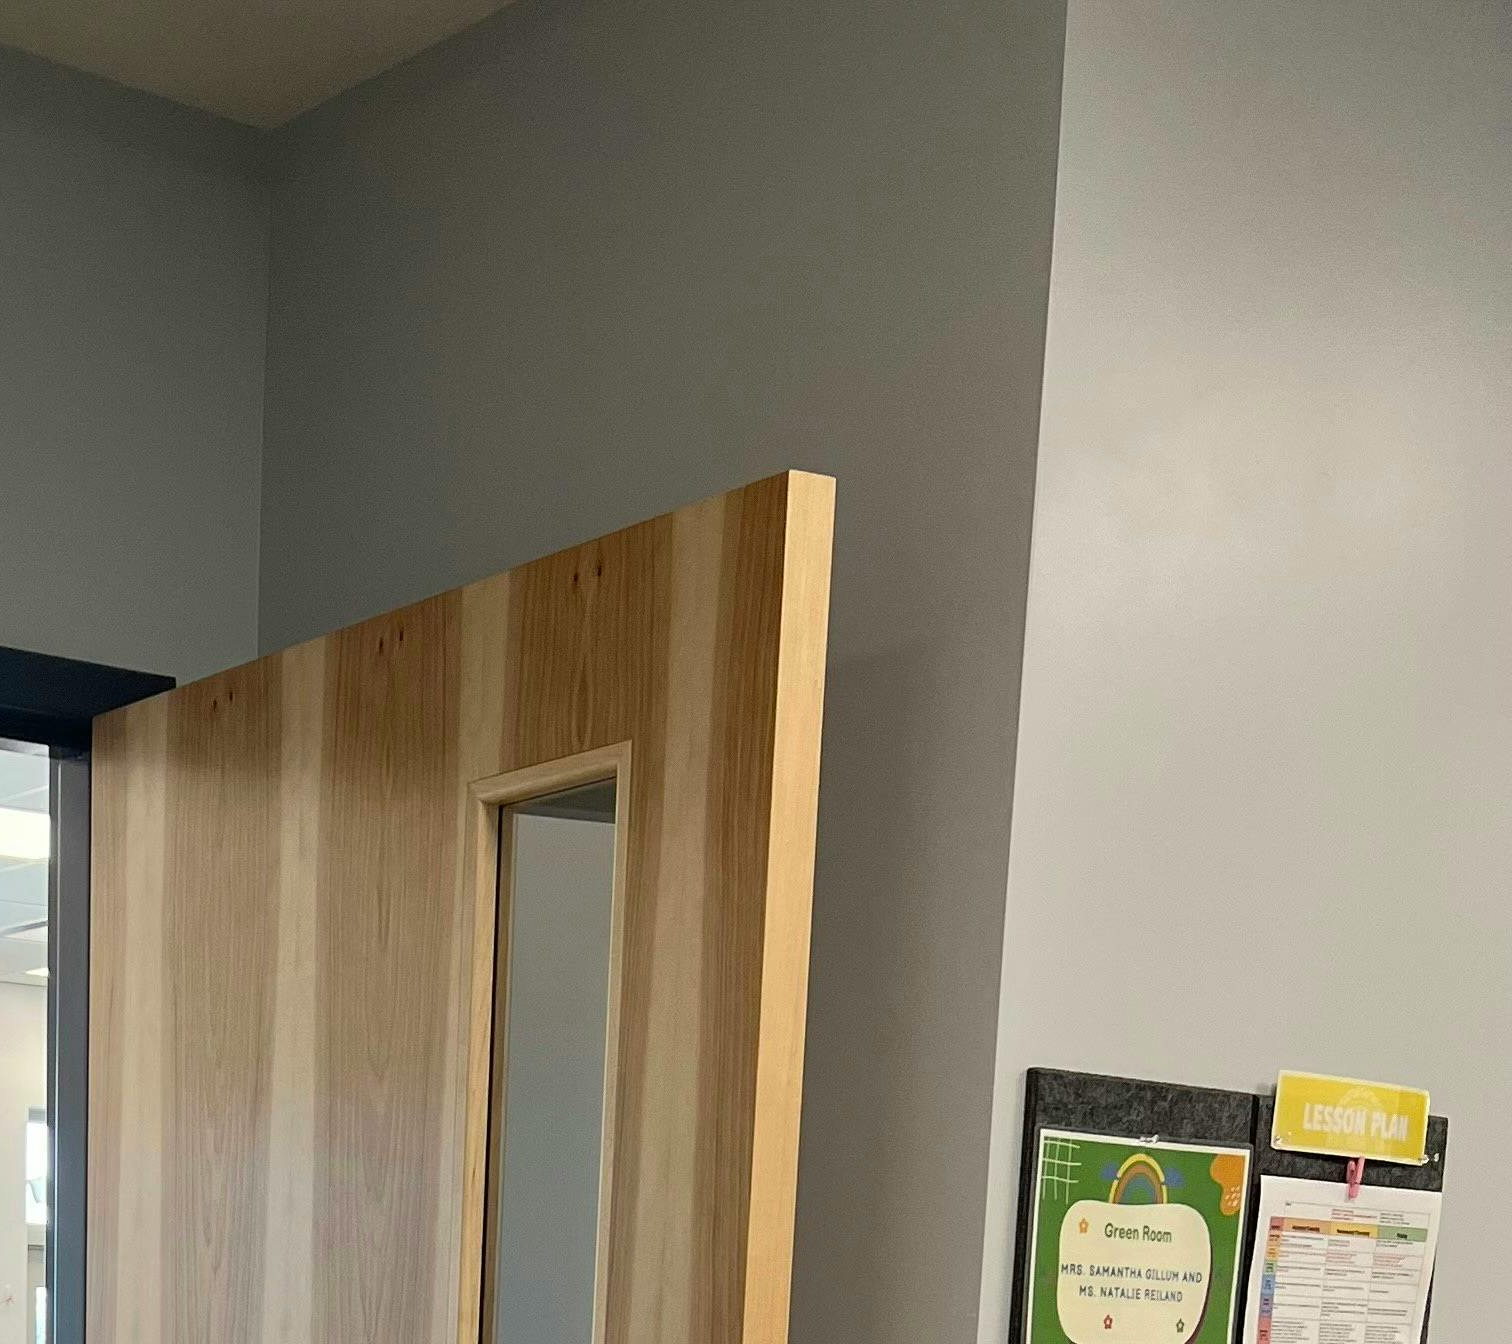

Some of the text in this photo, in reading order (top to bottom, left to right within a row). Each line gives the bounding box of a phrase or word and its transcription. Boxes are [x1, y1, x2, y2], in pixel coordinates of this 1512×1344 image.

[1303, 1103, 1410, 1142] LESSON PLAN
[1104, 1223, 1172, 1243] Green Room
[1061, 1264, 1085, 1276] MRS.
[1089, 1265, 1142, 1279] SAMANTHA
[1182, 1272, 1203, 1283] AND
[1079, 1285, 1095, 1297] MS.
[1100, 1287, 1141, 1300] NATALIE
